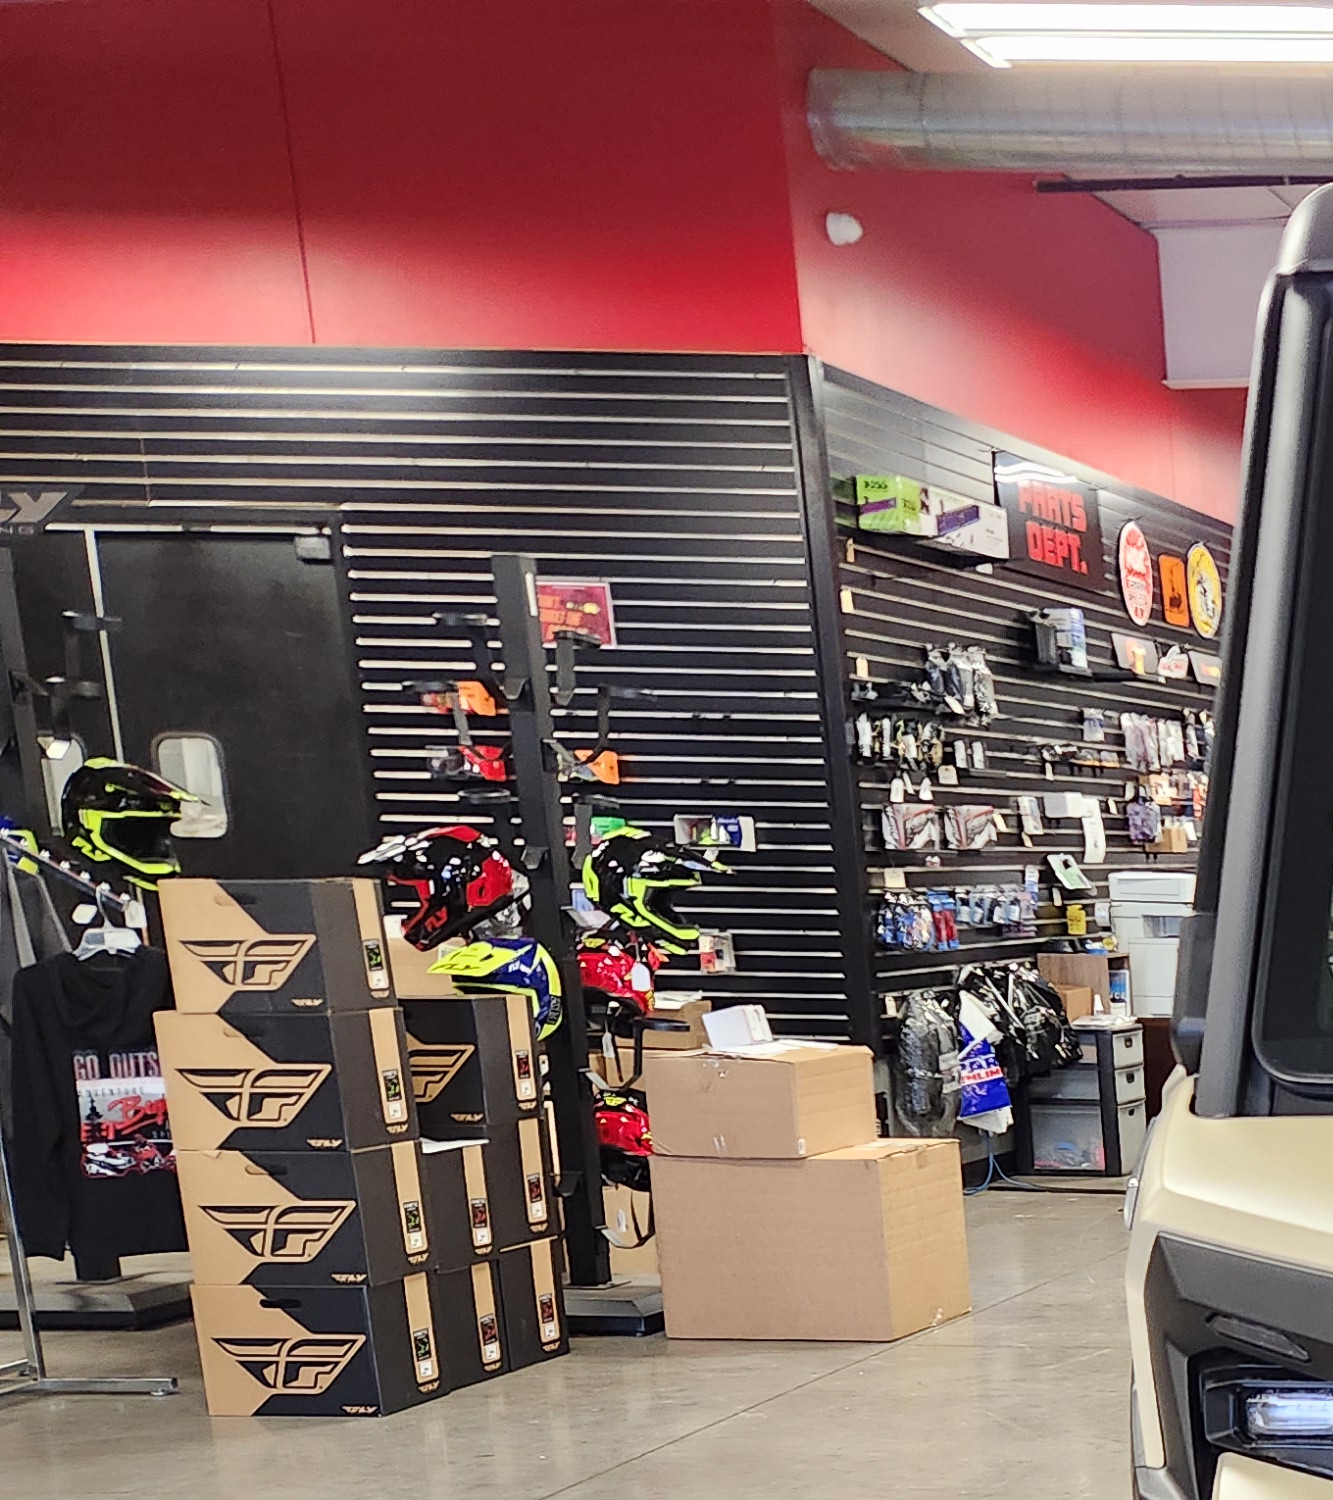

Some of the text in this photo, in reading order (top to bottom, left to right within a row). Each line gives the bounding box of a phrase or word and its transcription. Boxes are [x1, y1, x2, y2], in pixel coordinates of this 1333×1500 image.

[1017, 479, 1088, 533] PARTS
[1025, 521, 1089, 576] DEPT.
[73, 1051, 99, 1080] GO
